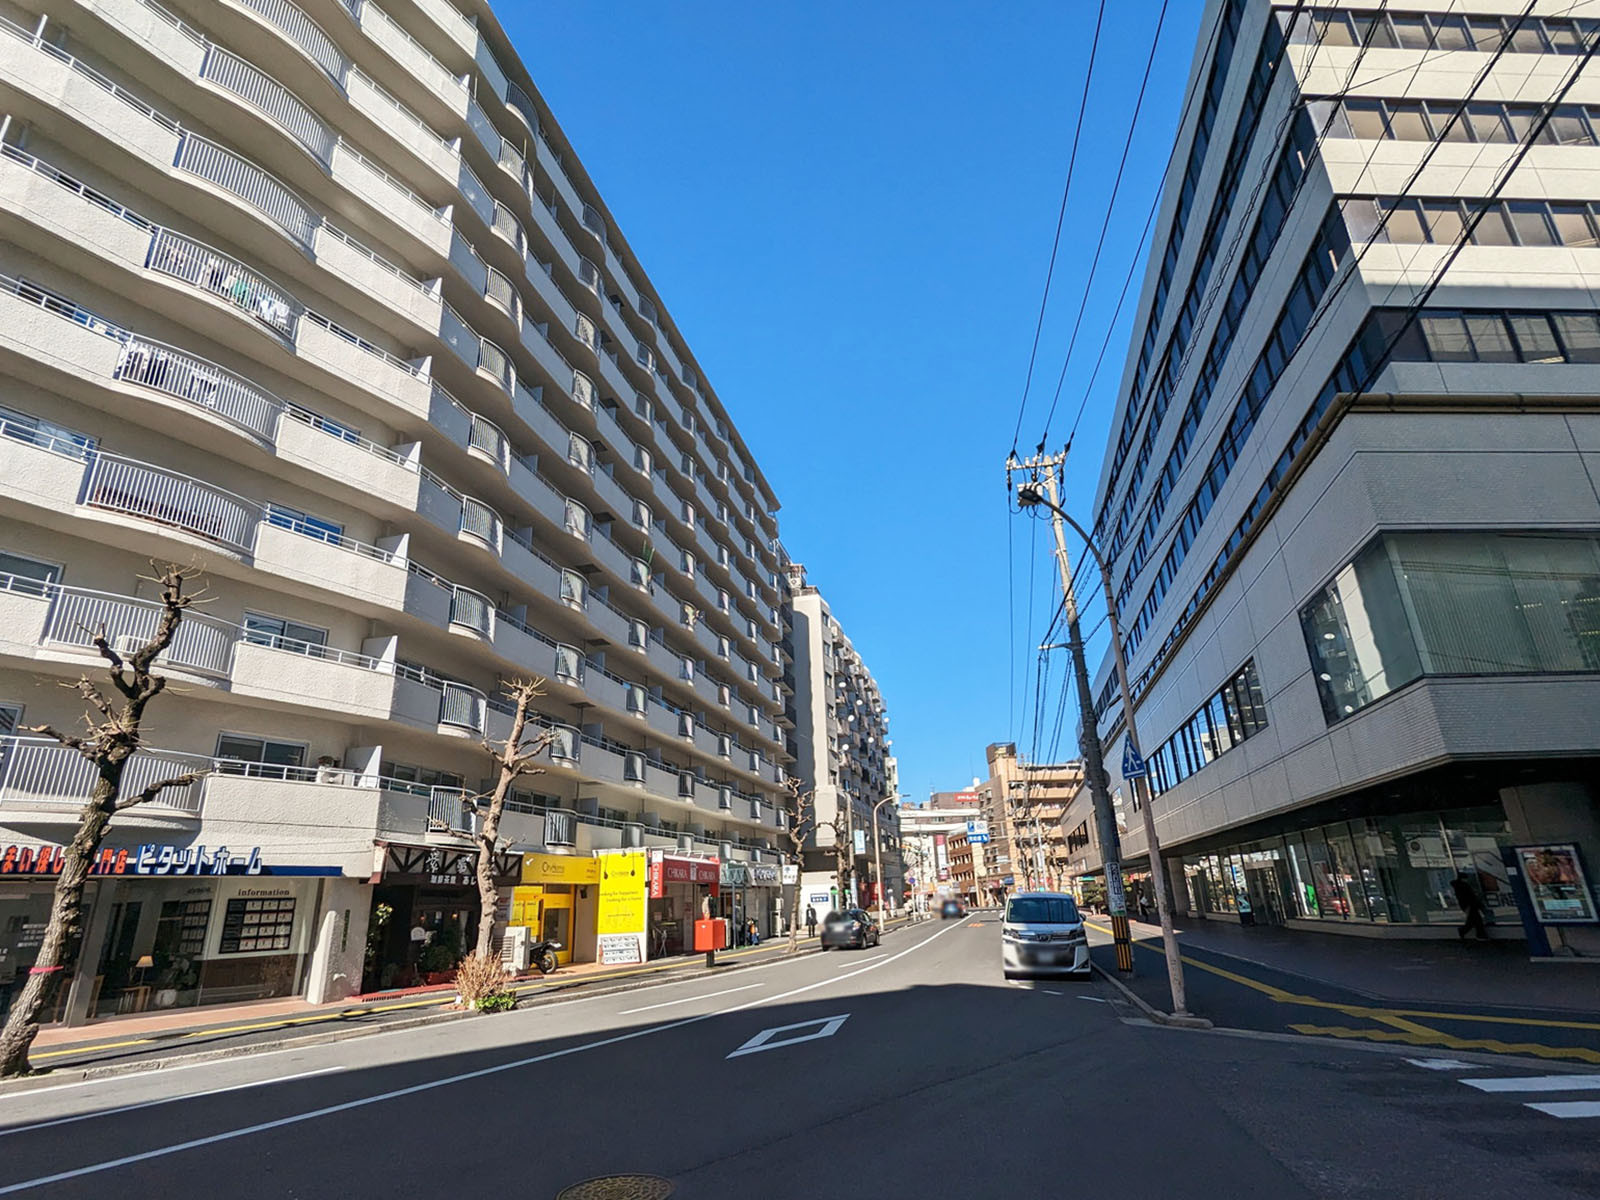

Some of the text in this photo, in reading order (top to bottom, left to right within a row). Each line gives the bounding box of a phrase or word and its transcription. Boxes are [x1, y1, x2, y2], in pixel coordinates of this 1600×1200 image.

[0, 843, 262, 875] まい探し門店 ピタットホーム
[238, 888, 290, 896] information
